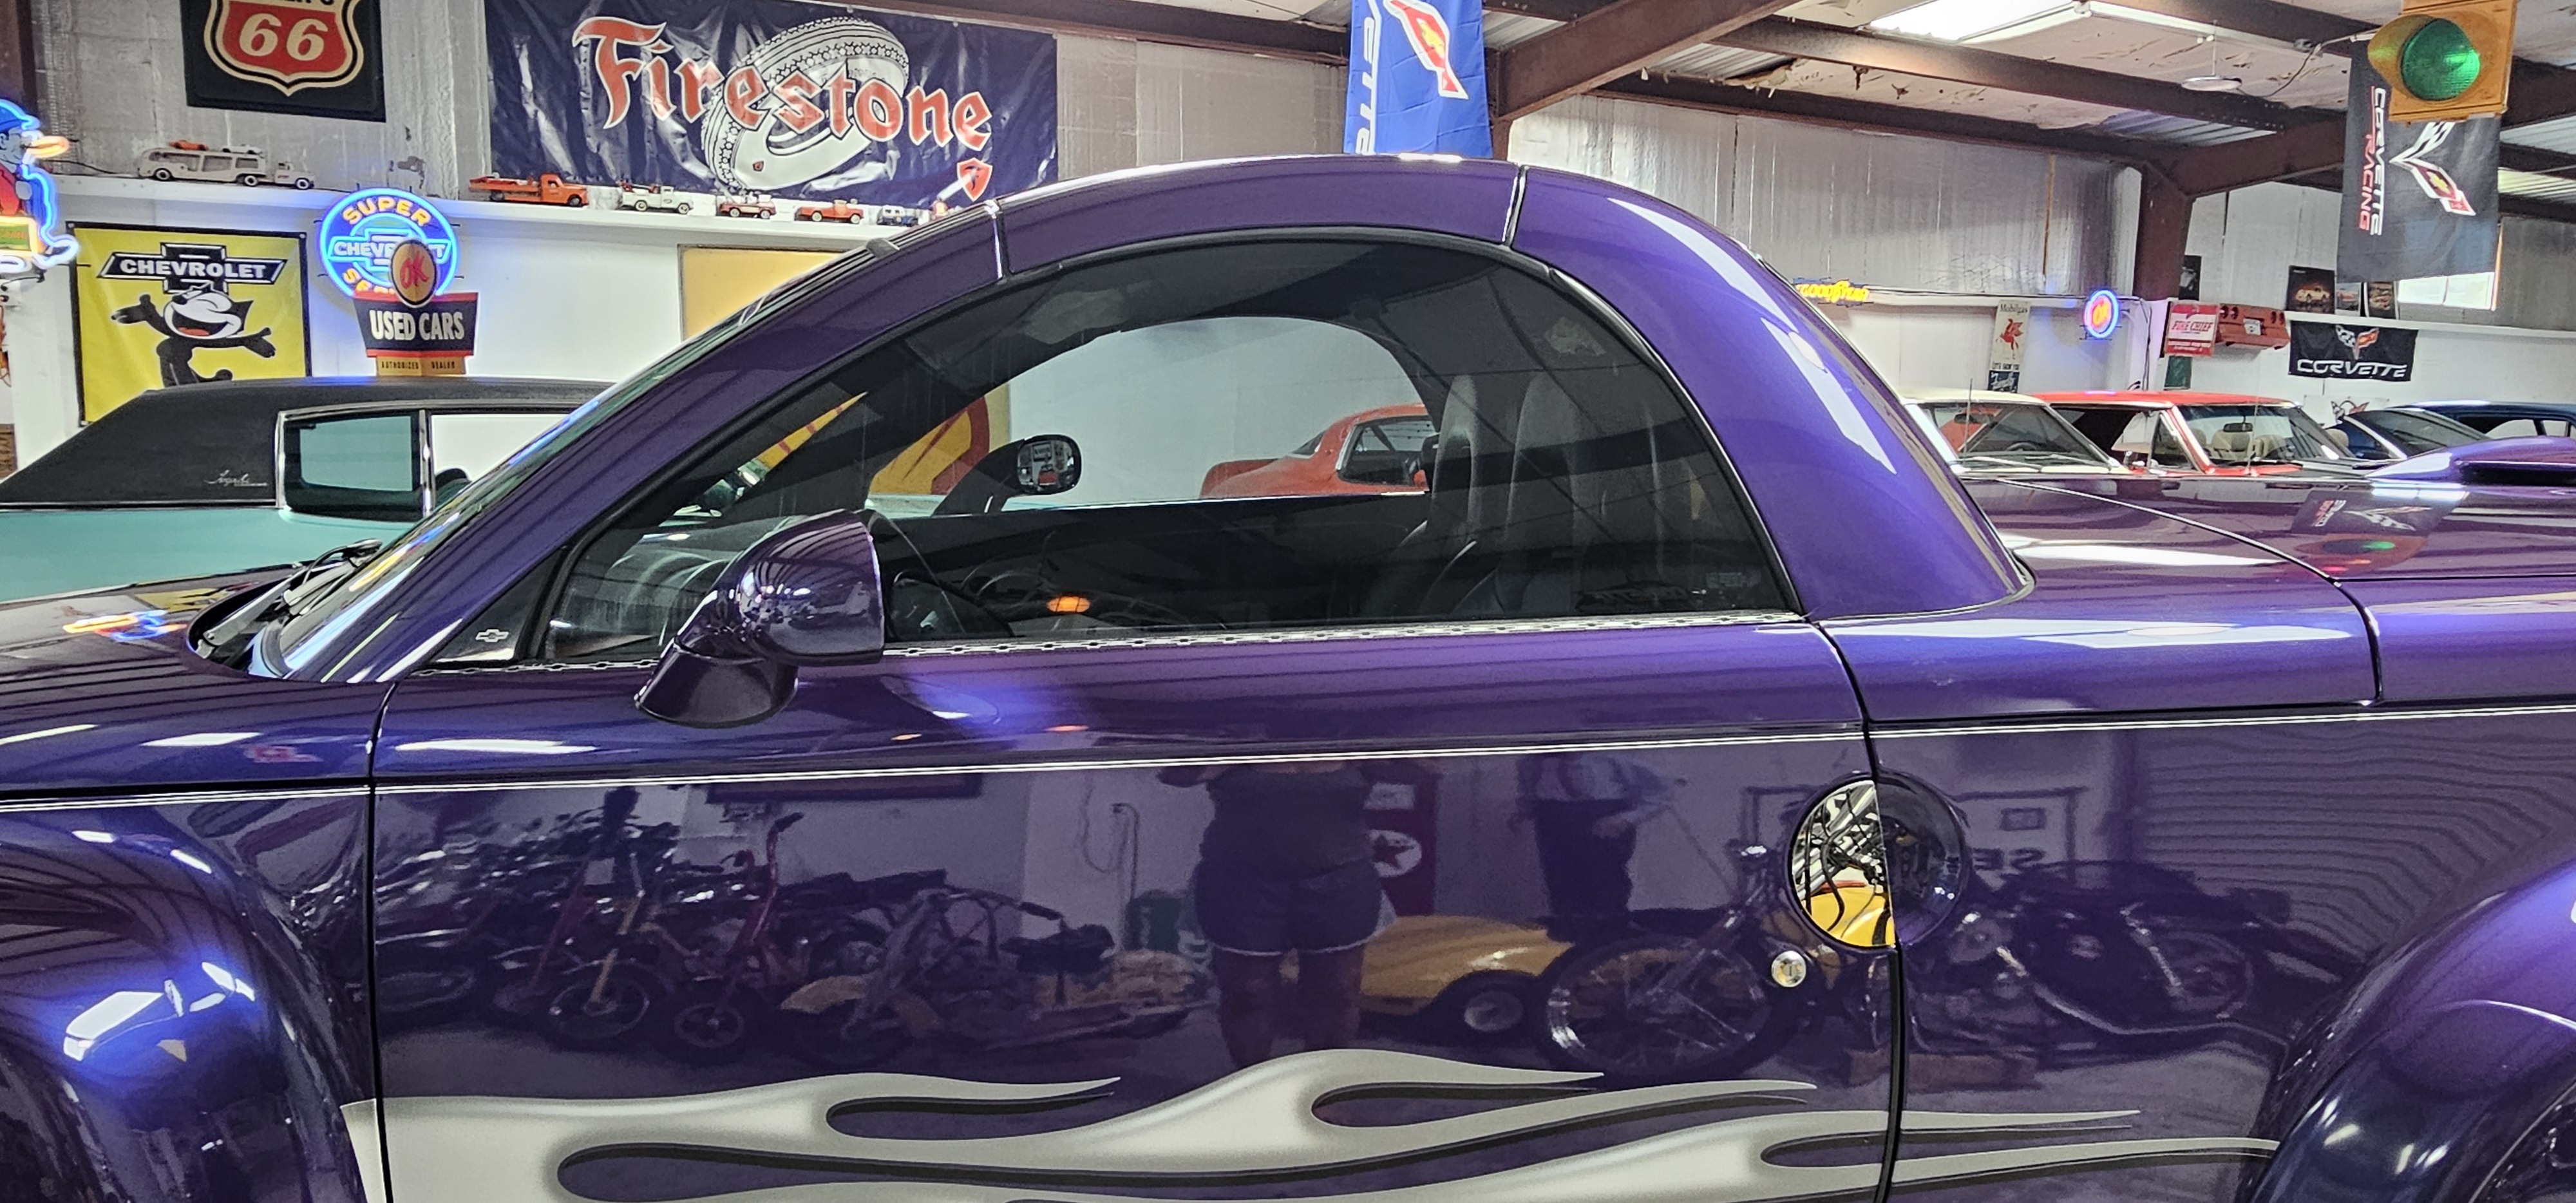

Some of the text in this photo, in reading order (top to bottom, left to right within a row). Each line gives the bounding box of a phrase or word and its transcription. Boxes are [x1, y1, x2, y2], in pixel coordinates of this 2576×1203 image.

[239, 13, 328, 61] 66
[572, 16, 992, 151] Firestone
[2359, 86, 2376, 231] RACING
[2370, 88, 2386, 236] CORVETTE
[343, 196, 431, 227] SUPER
[120, 259, 266, 278] CHEVROLET
[399, 251, 430, 289] OK
[369, 310, 464, 341] USED CARS
[381, 361, 419, 370] AUTHORIZED
[2297, 359, 2407, 378] CORVETTE
